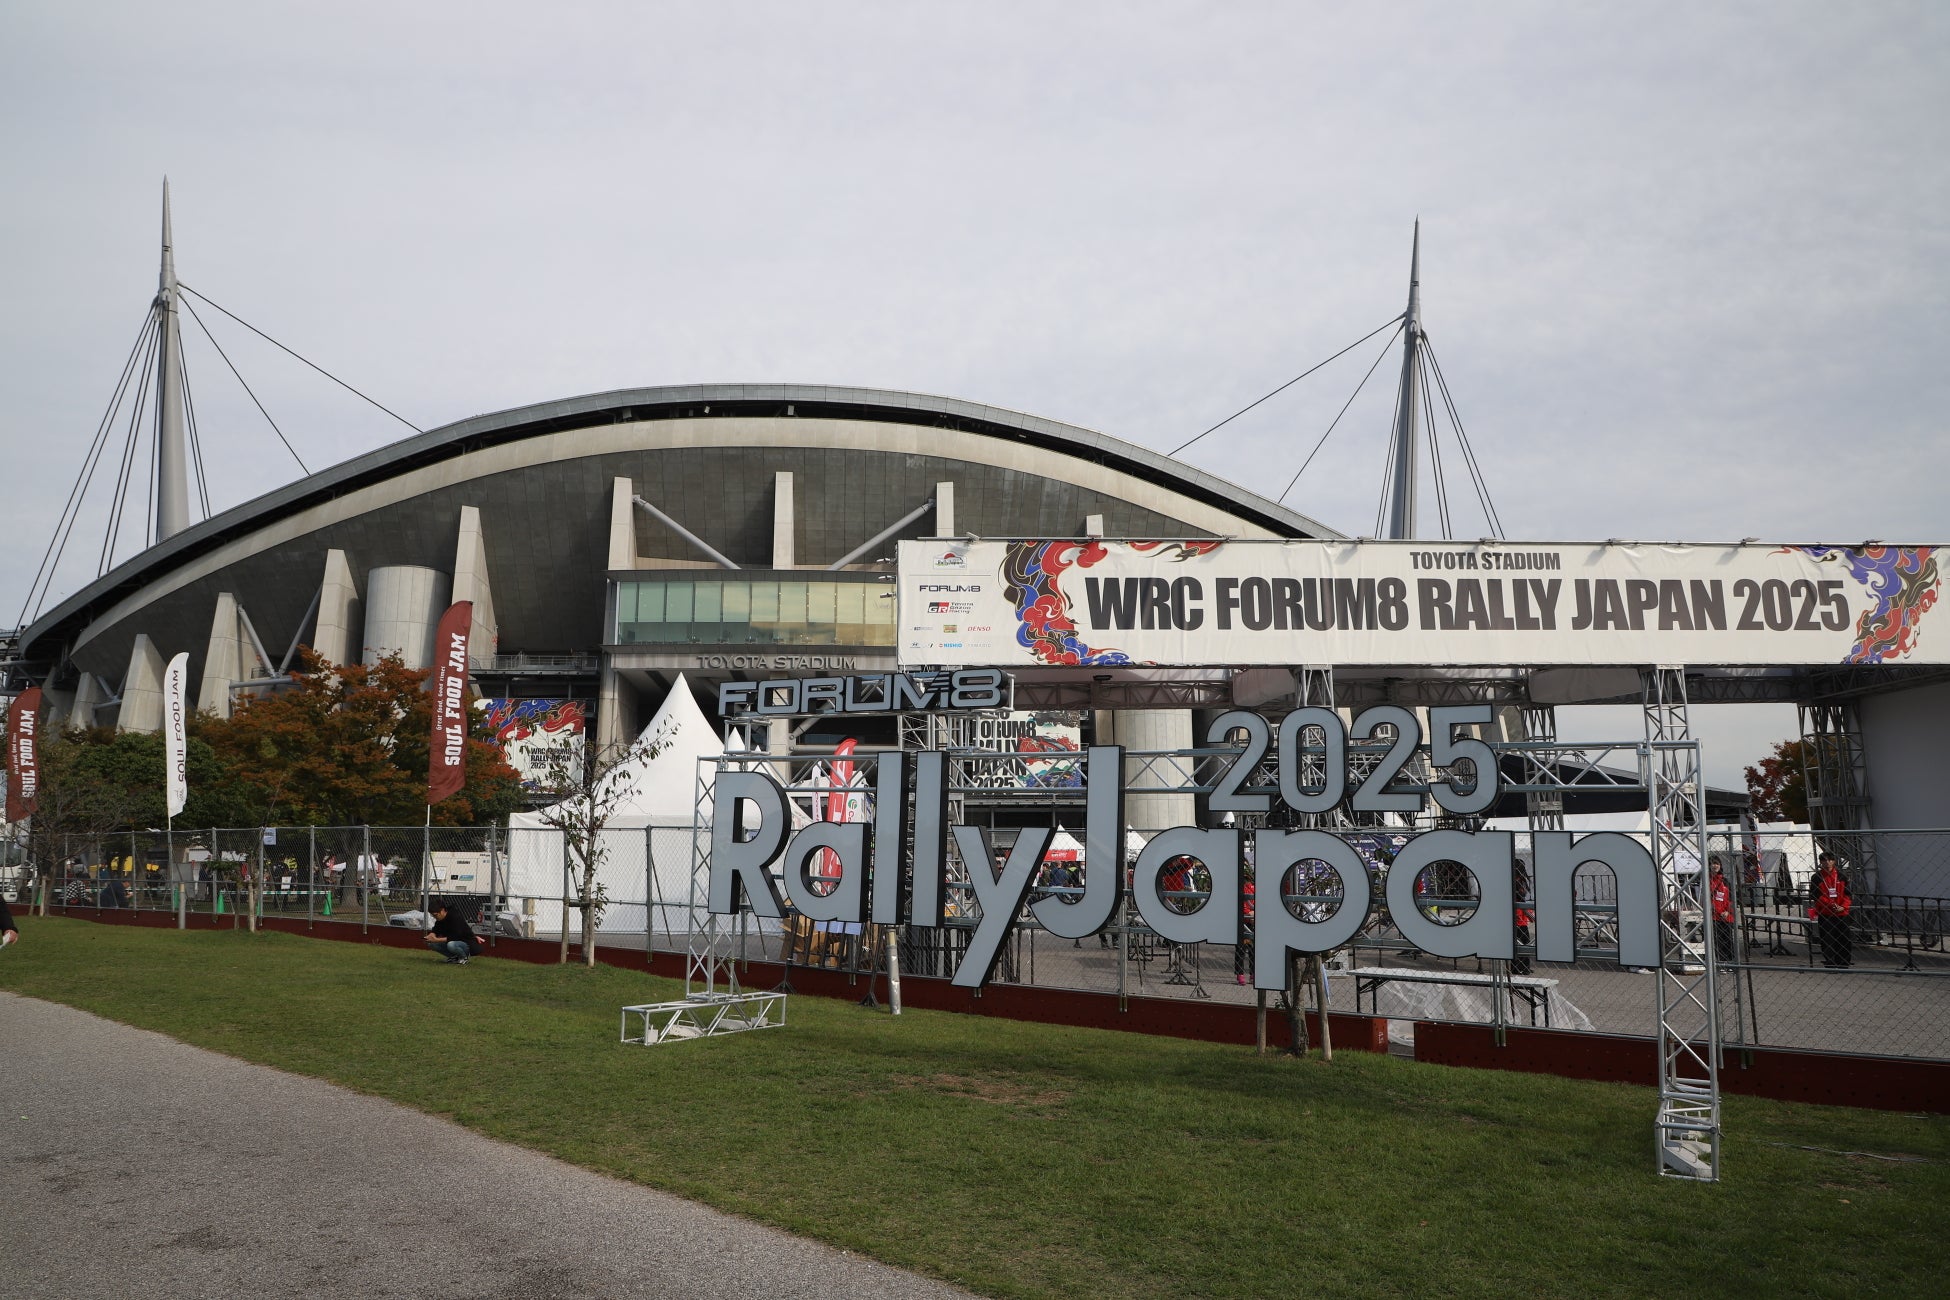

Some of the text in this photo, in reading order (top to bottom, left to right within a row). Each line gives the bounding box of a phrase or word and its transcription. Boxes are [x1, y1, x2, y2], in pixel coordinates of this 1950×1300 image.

[1410, 551, 1561, 571] TOYOTA STADIUM
[1085, 577, 1851, 632] WRC FORUM8 RALLY JAPAN 2025
[697, 655, 857, 670] TOYOTA STADIUM
[445, 632, 466, 766] SOUL FOOD JAM
[717, 668, 1008, 717] FORUM8
[173, 703, 182, 742] FOOD
[19, 710, 35, 797] SOUL FOOD JAM
[177, 742, 186, 782] SOUL
[1206, 704, 1500, 815] 2025
